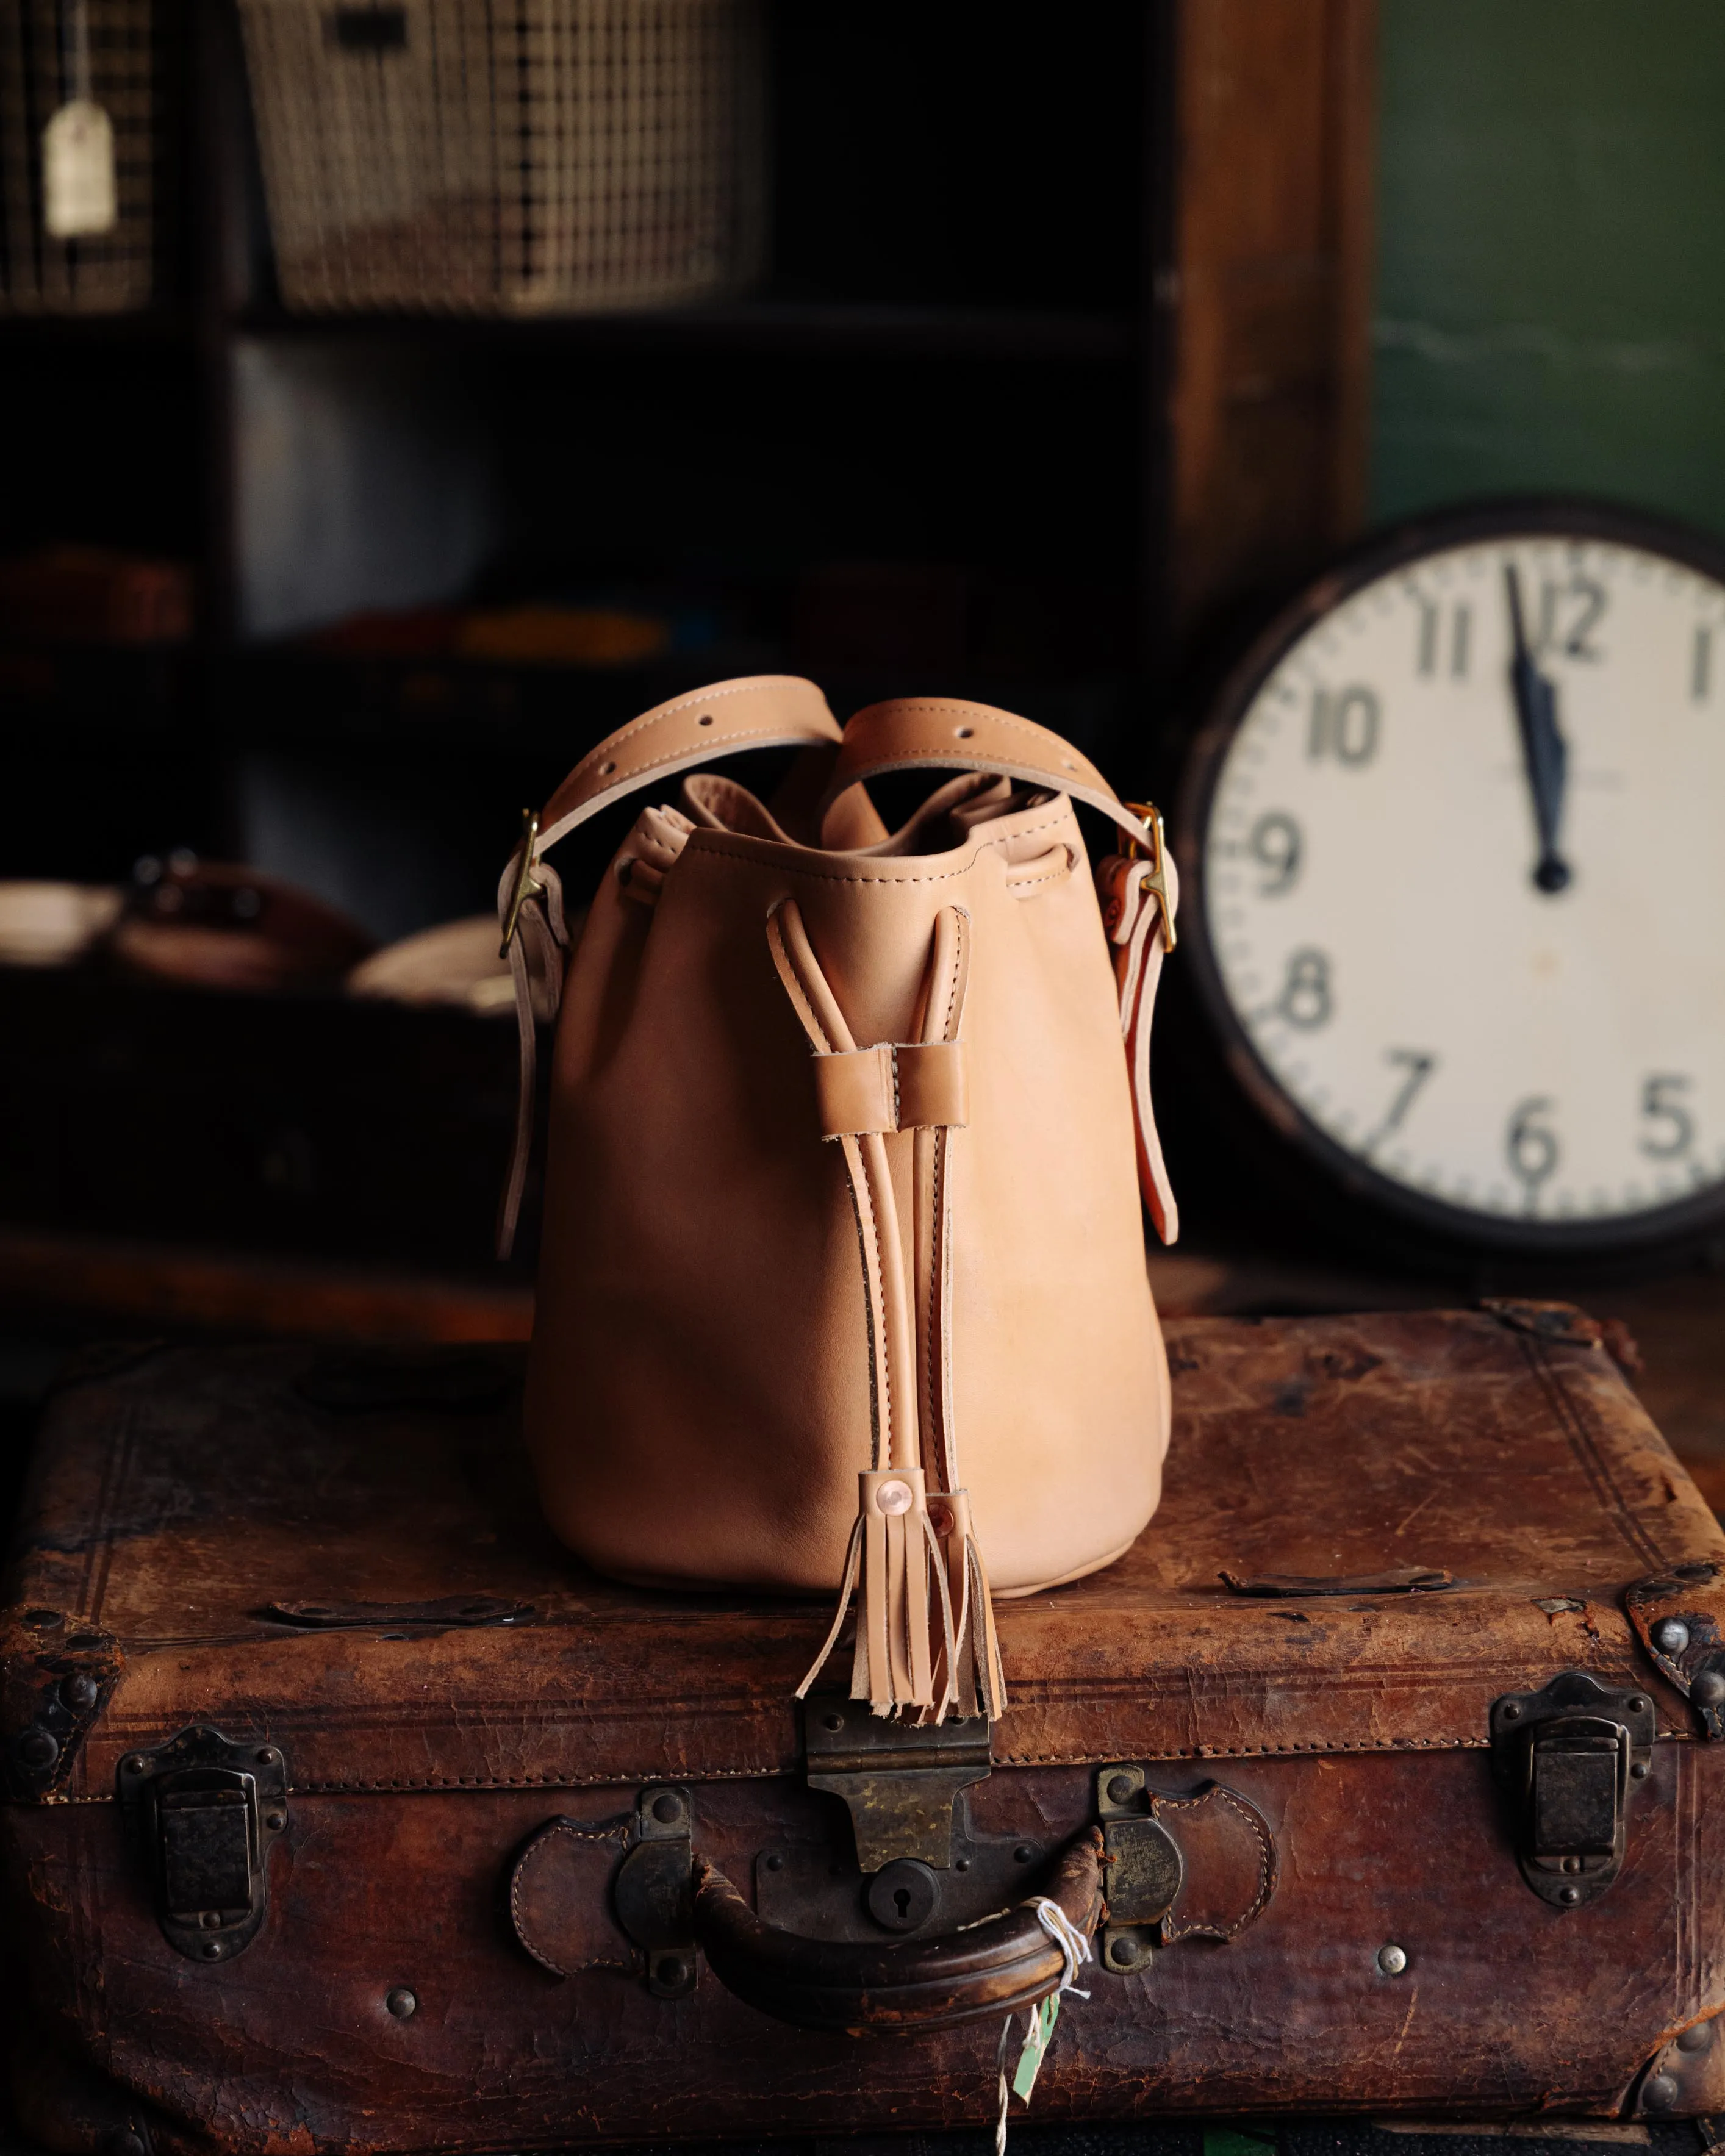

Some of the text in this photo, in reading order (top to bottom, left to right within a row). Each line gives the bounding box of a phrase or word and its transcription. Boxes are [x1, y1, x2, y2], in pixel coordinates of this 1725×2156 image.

[1414, 600, 1471, 679] 11
[1537, 578, 1608, 662] 12
[1690, 623, 1715, 703] 1
[1304, 686, 1379, 766] 10
[1254, 814, 1303, 897] 9
[1280, 950, 1333, 1031] 8
[1388, 1049, 1436, 1130] 7
[1642, 1075, 1693, 1161] 5
[1508, 1099, 1558, 1186] 6
